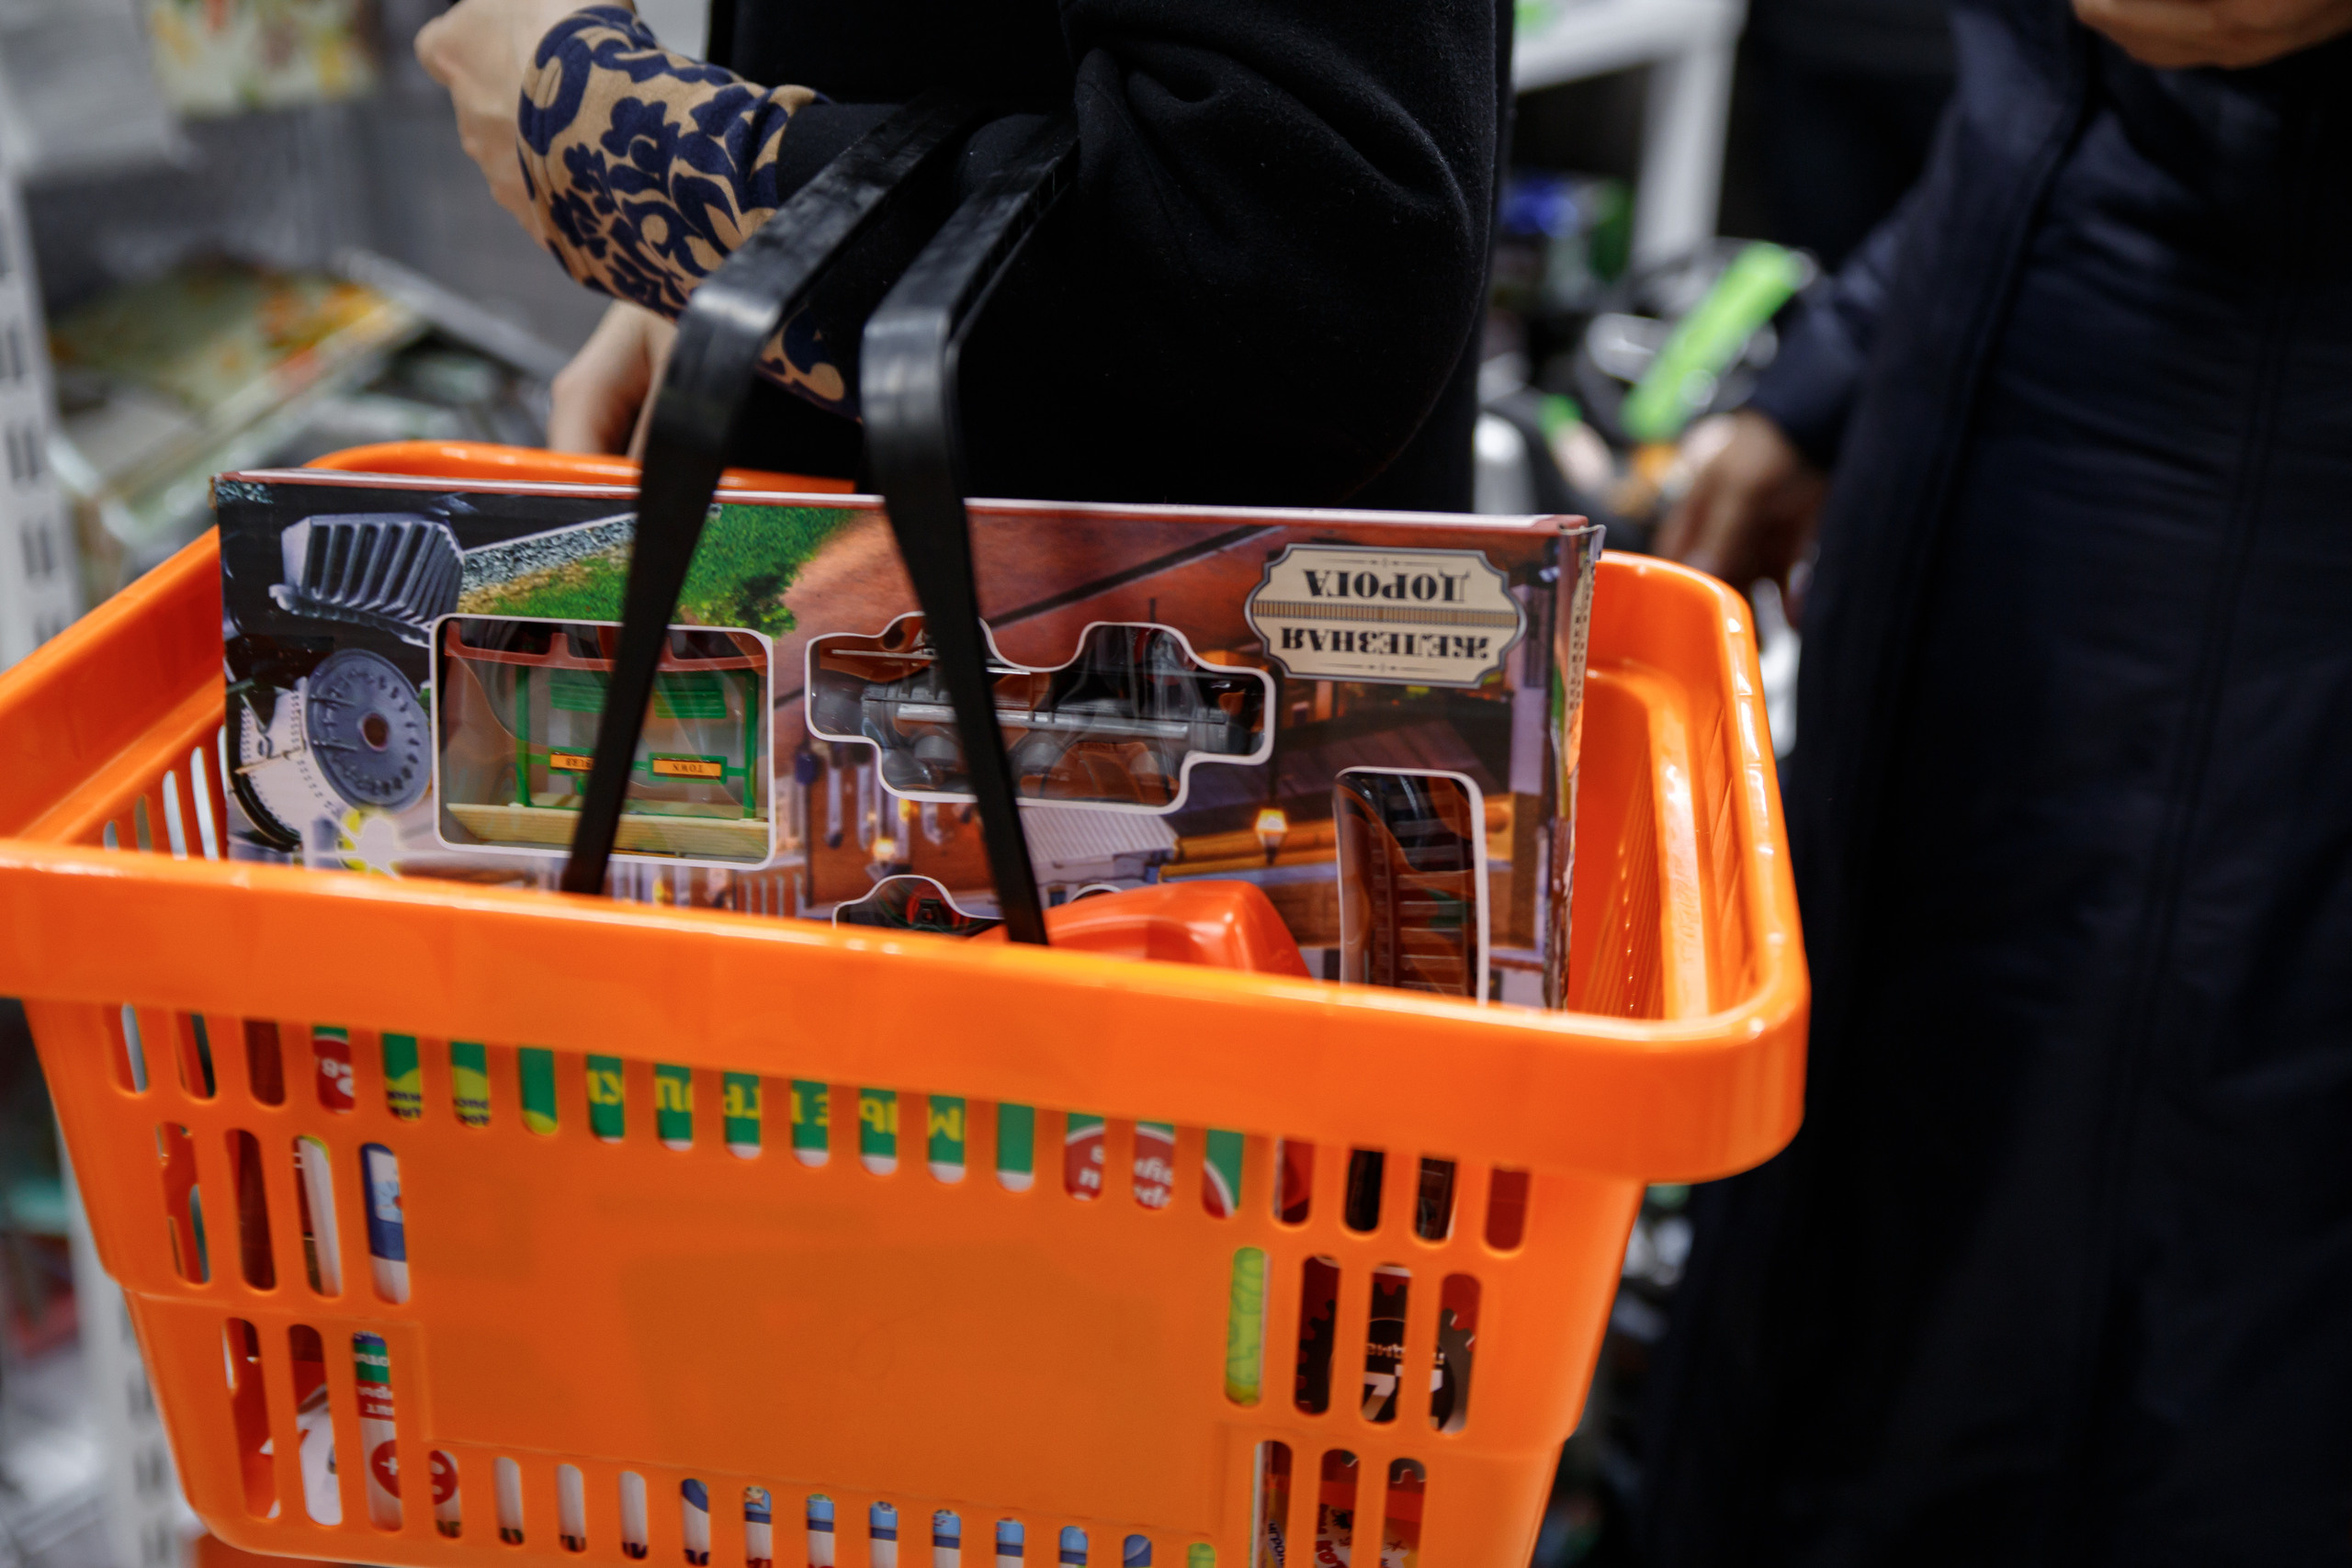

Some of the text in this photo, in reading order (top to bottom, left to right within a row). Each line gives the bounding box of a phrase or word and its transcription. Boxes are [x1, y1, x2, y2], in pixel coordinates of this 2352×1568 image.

[1302, 569, 1470, 604] ДОРОГА
[1280, 626, 1490, 661] ЖЕЛЕЗНАЯ
[672, 762, 704, 773] TOWN
